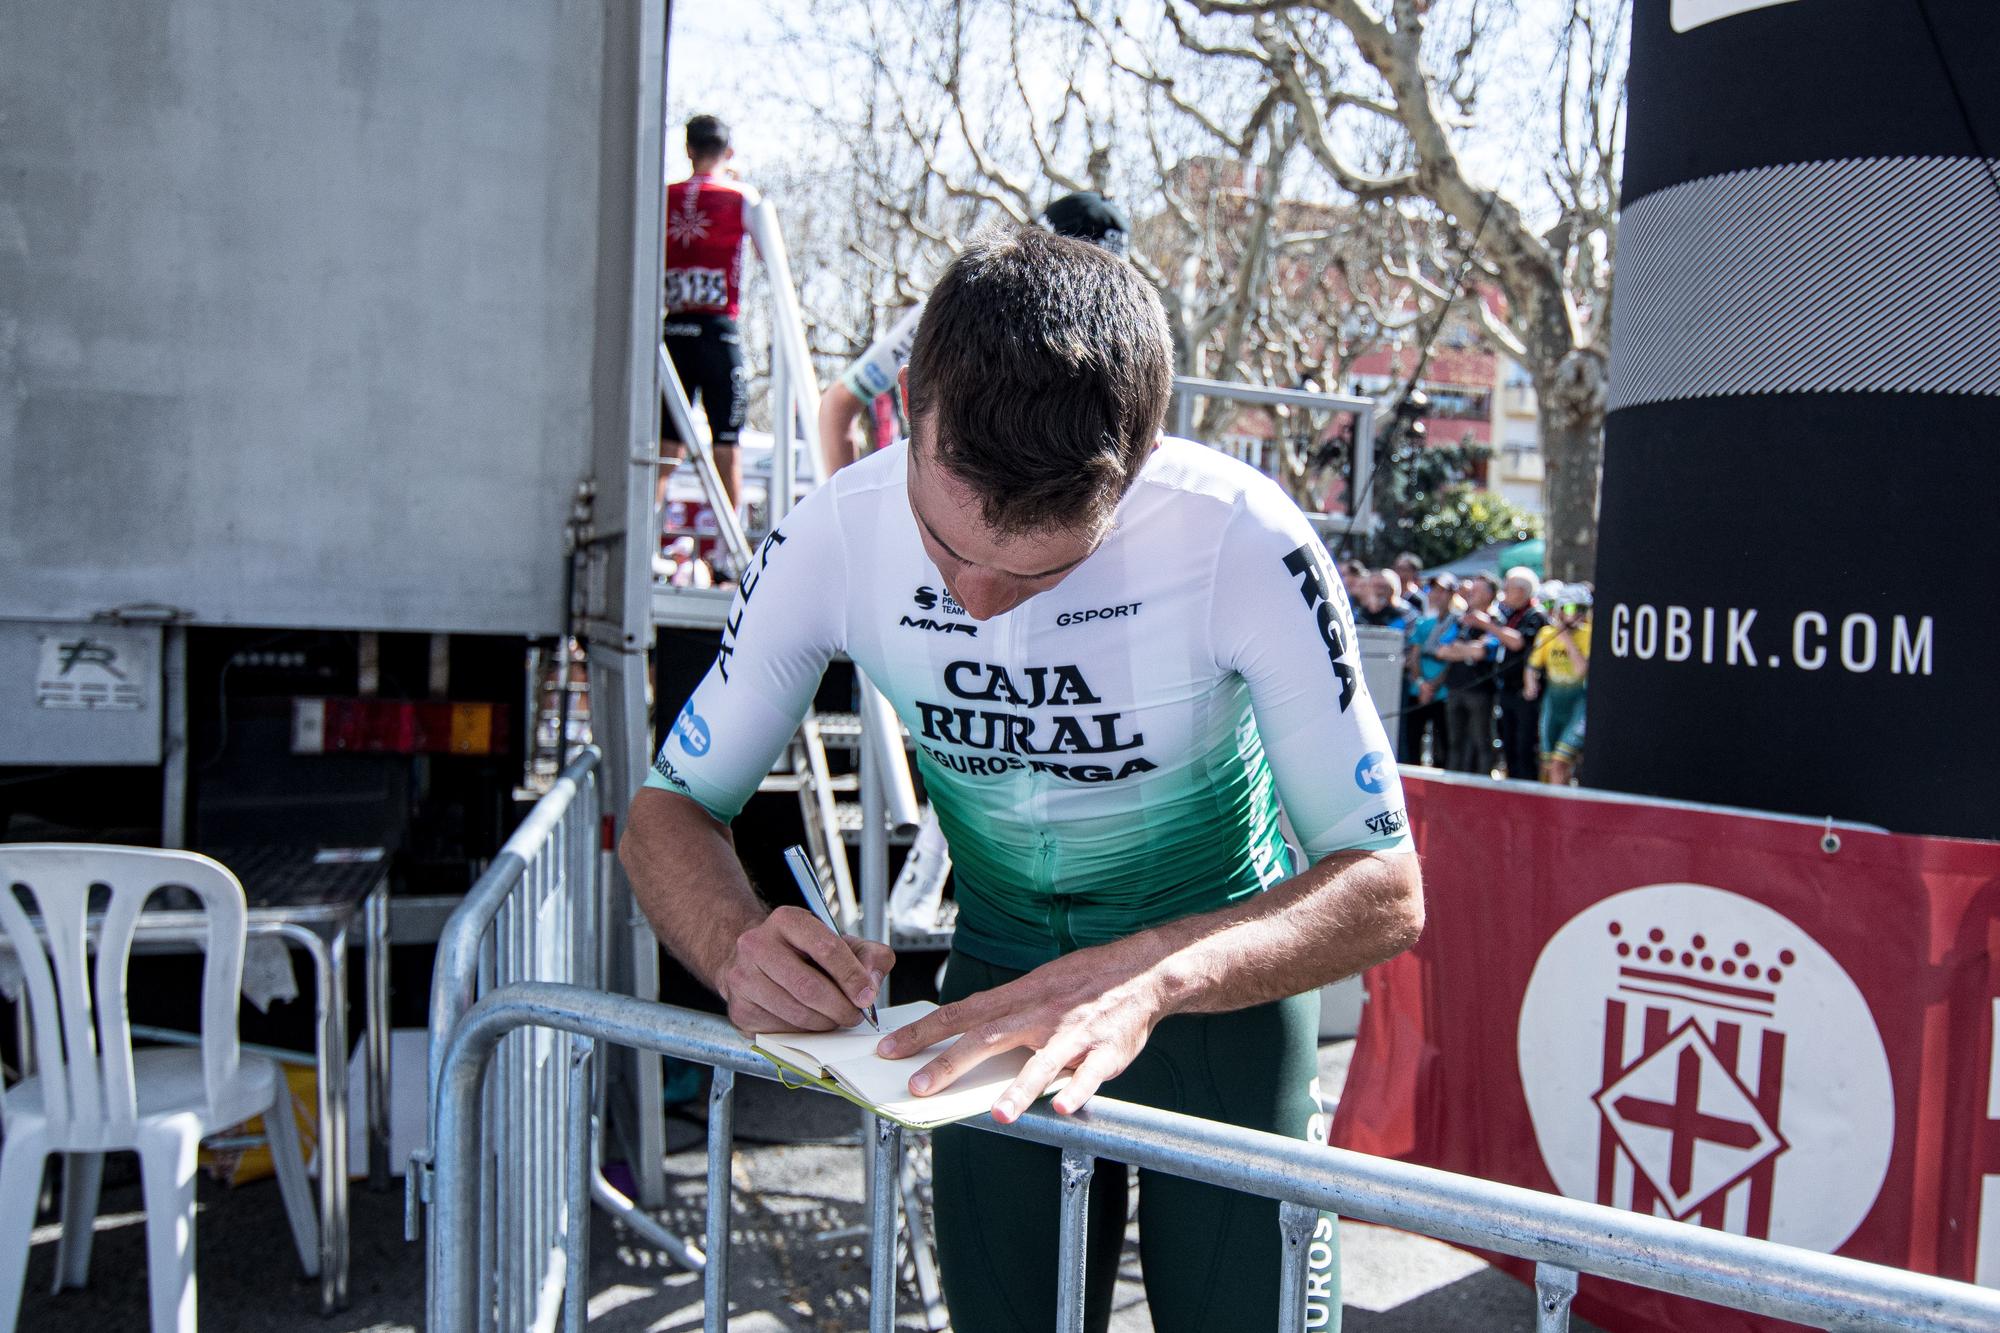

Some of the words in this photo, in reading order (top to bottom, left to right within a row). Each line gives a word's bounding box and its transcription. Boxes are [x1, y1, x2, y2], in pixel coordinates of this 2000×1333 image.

[899, 615, 978, 637] MMR
[942, 605, 965, 616] TEAM
[1056, 602, 1142, 627] GSPORT
[1282, 542, 1357, 714] RGA
[1610, 602, 1934, 676] GOBIK.COM
[943, 660, 1101, 709] CAJA
[677, 708, 708, 752] MC
[915, 700, 1144, 755] RURAL
[919, 742, 1026, 777] EGUROS
[1028, 757, 1159, 783] RGA
[1305, 1216, 1333, 1333] UROS
